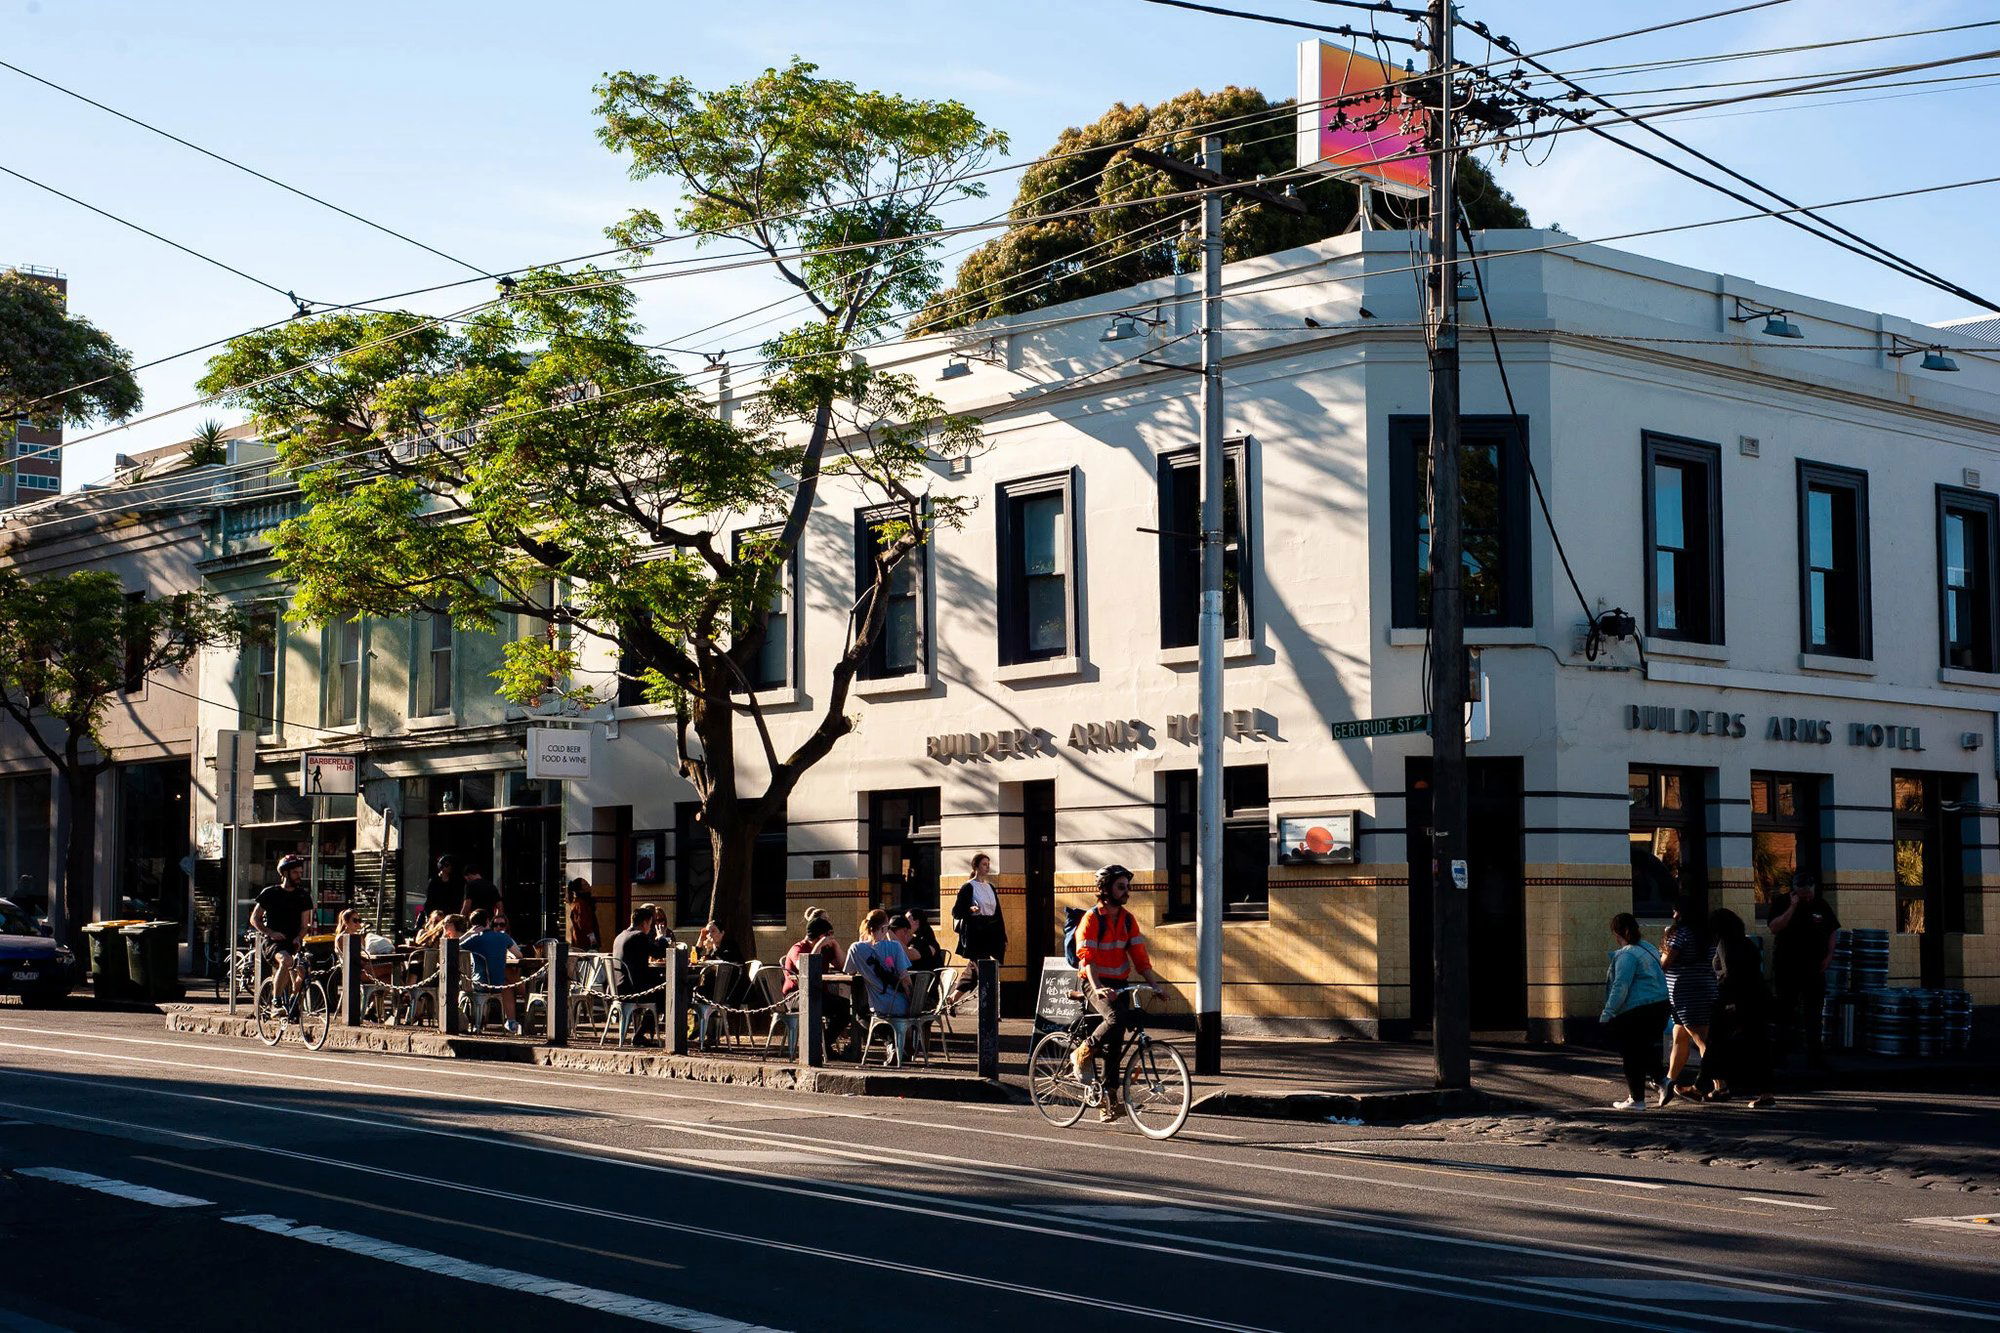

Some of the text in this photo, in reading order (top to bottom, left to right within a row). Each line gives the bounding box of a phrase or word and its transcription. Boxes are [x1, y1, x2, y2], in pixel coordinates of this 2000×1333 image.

[1333, 717, 1411, 738] GERTRUDE ST
[1625, 703, 1926, 751] BUILDERS ARMS HOTEL
[926, 726, 1044, 758] BUILDERS
[1067, 718, 1142, 747] ARMS
[547, 744, 581, 753] COLD BEER
[309, 757, 354, 765] BARBERELLA
[541, 754, 587, 764] FOOD & WINE
